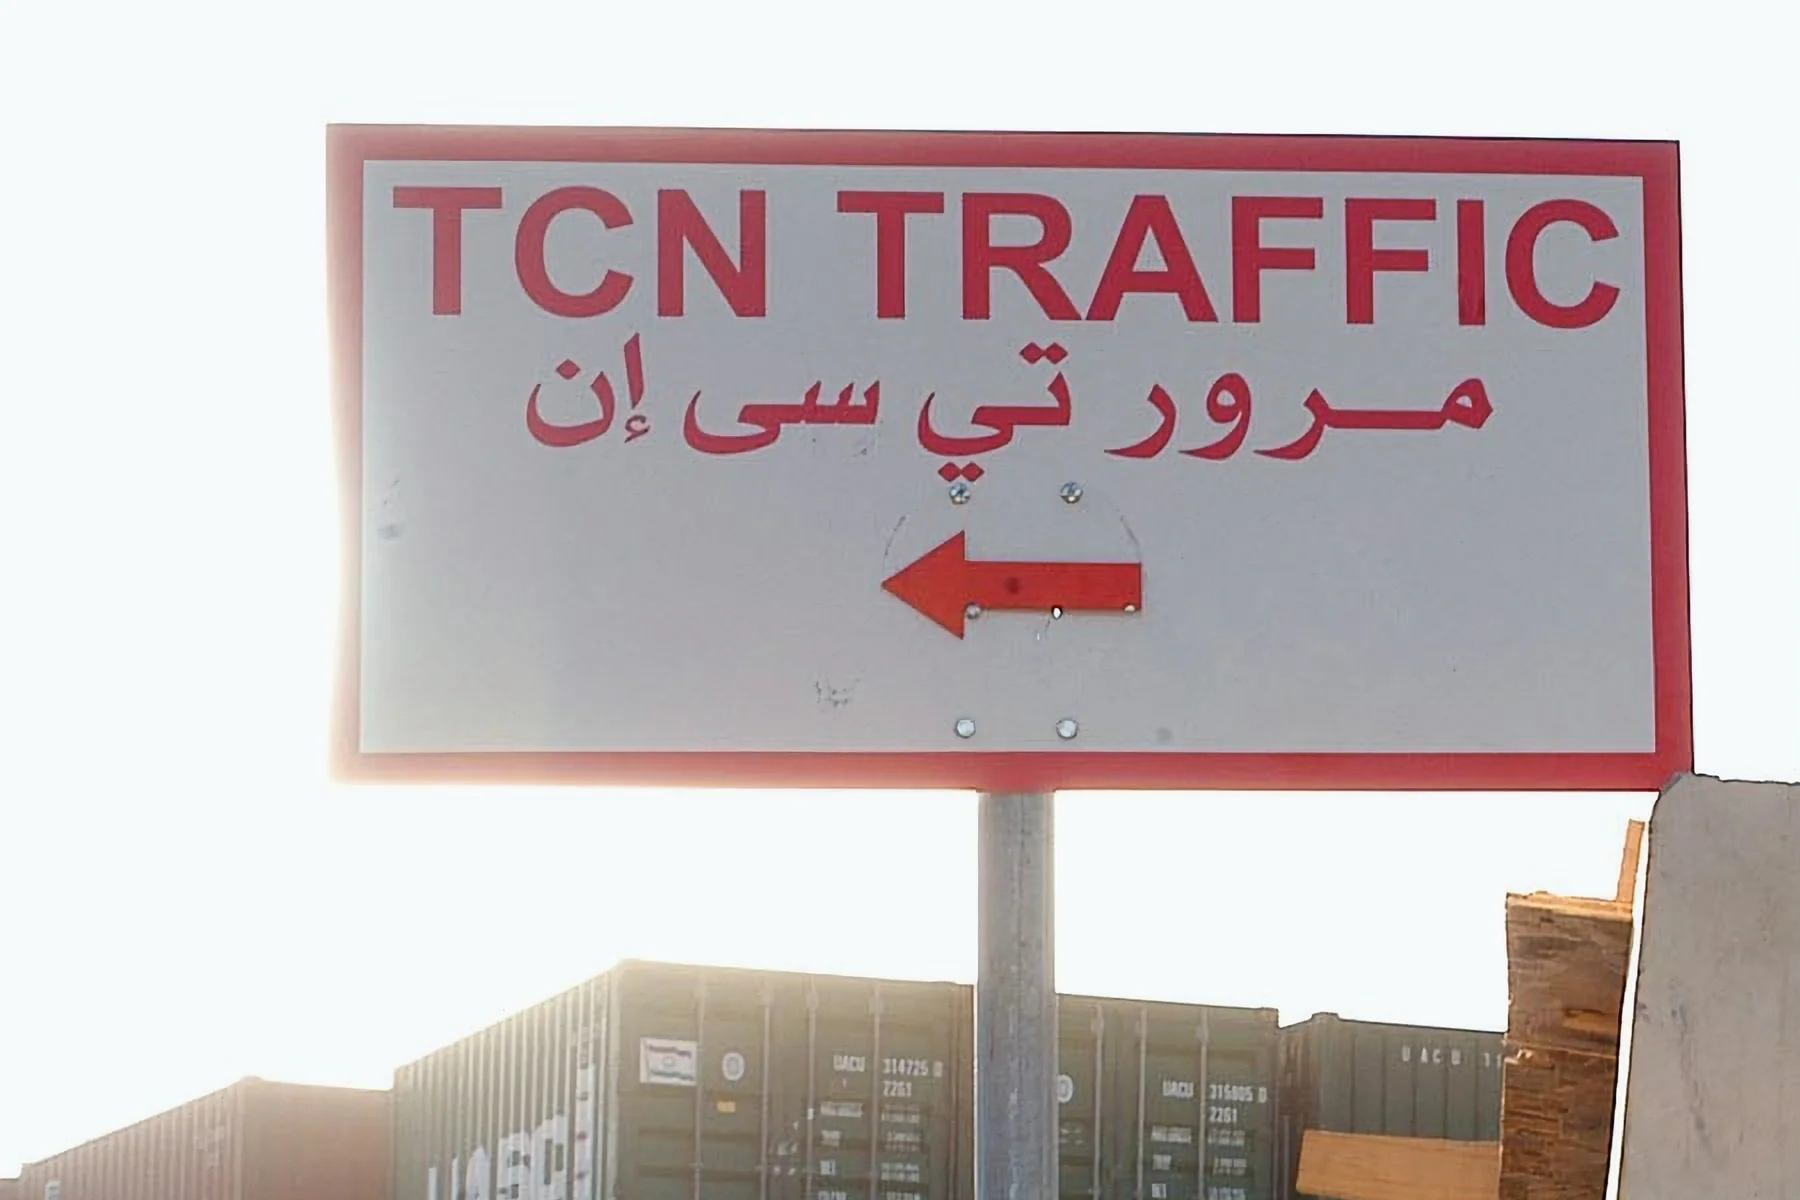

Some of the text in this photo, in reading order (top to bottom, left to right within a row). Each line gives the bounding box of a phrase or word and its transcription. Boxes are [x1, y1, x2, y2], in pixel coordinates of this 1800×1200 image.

[393, 186, 1621, 329] TCN TRAFFIC
[1103, 372, 1494, 461] مرور
